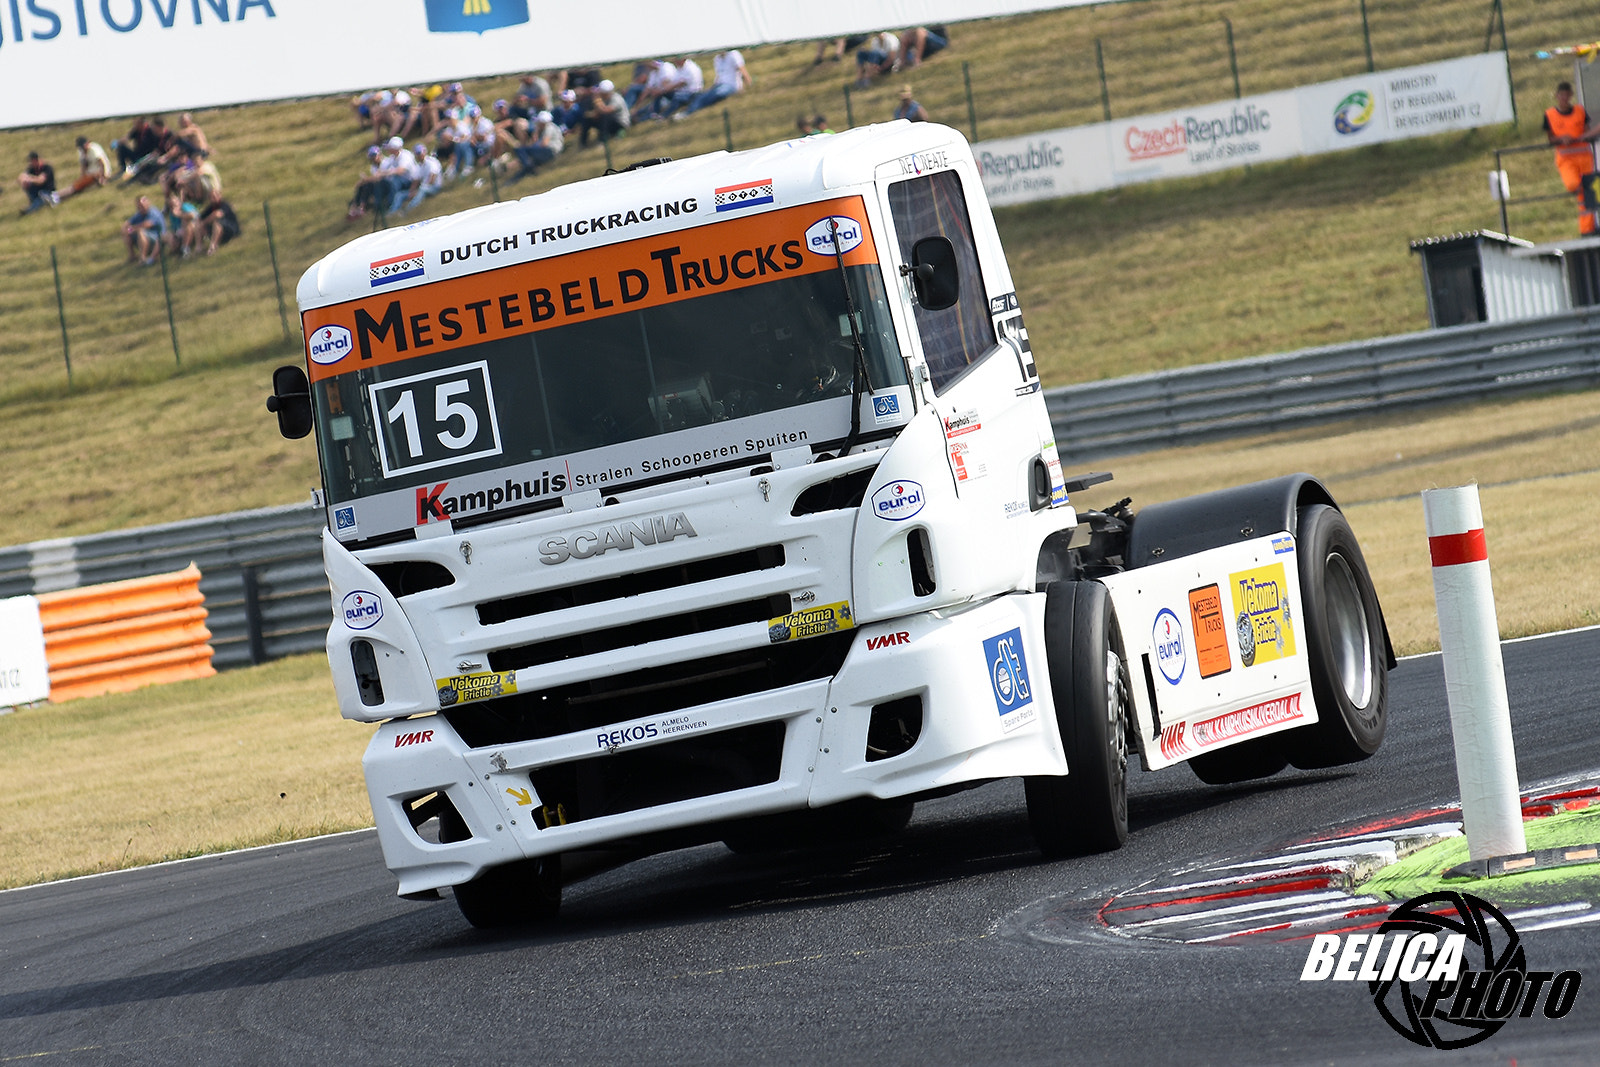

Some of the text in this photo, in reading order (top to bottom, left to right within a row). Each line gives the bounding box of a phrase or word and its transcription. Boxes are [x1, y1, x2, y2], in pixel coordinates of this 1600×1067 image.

[1391, 74, 1438, 93] MINISTRY
[1392, 89, 1457, 111] OF REGIONAL
[1395, 107, 1467, 129] DEVELOPMENT
[440, 198, 699, 265] DUTCH TRUCKRACING
[354, 240, 804, 361] MESTEBELD TRUCKS
[312, 335, 349, 357] eurol
[387, 378, 479, 458] 15
[943, 415, 970, 432] Kamphuis
[416, 430, 808, 526] Kamphuis Stralen Schooperen Spuiten
[879, 491, 921, 511] eurol
[538, 511, 698, 566] SCANIA
[1239, 577, 1280, 617] Vekoma
[346, 601, 378, 619] eurol
[783, 606, 834, 628] Vekoma
[796, 623, 827, 638] Frictie
[866, 631, 911, 651] VMR
[1158, 632, 1182, 660] eurol
[450, 673, 501, 692] Vekoma
[463, 686, 492, 702] Frictie
[597, 716, 689, 748] REKOS ALMELO
[663, 720, 708, 735] HEERENVEEN
[394, 730, 434, 748] VMR
[1160, 720, 1193, 760] VMR
